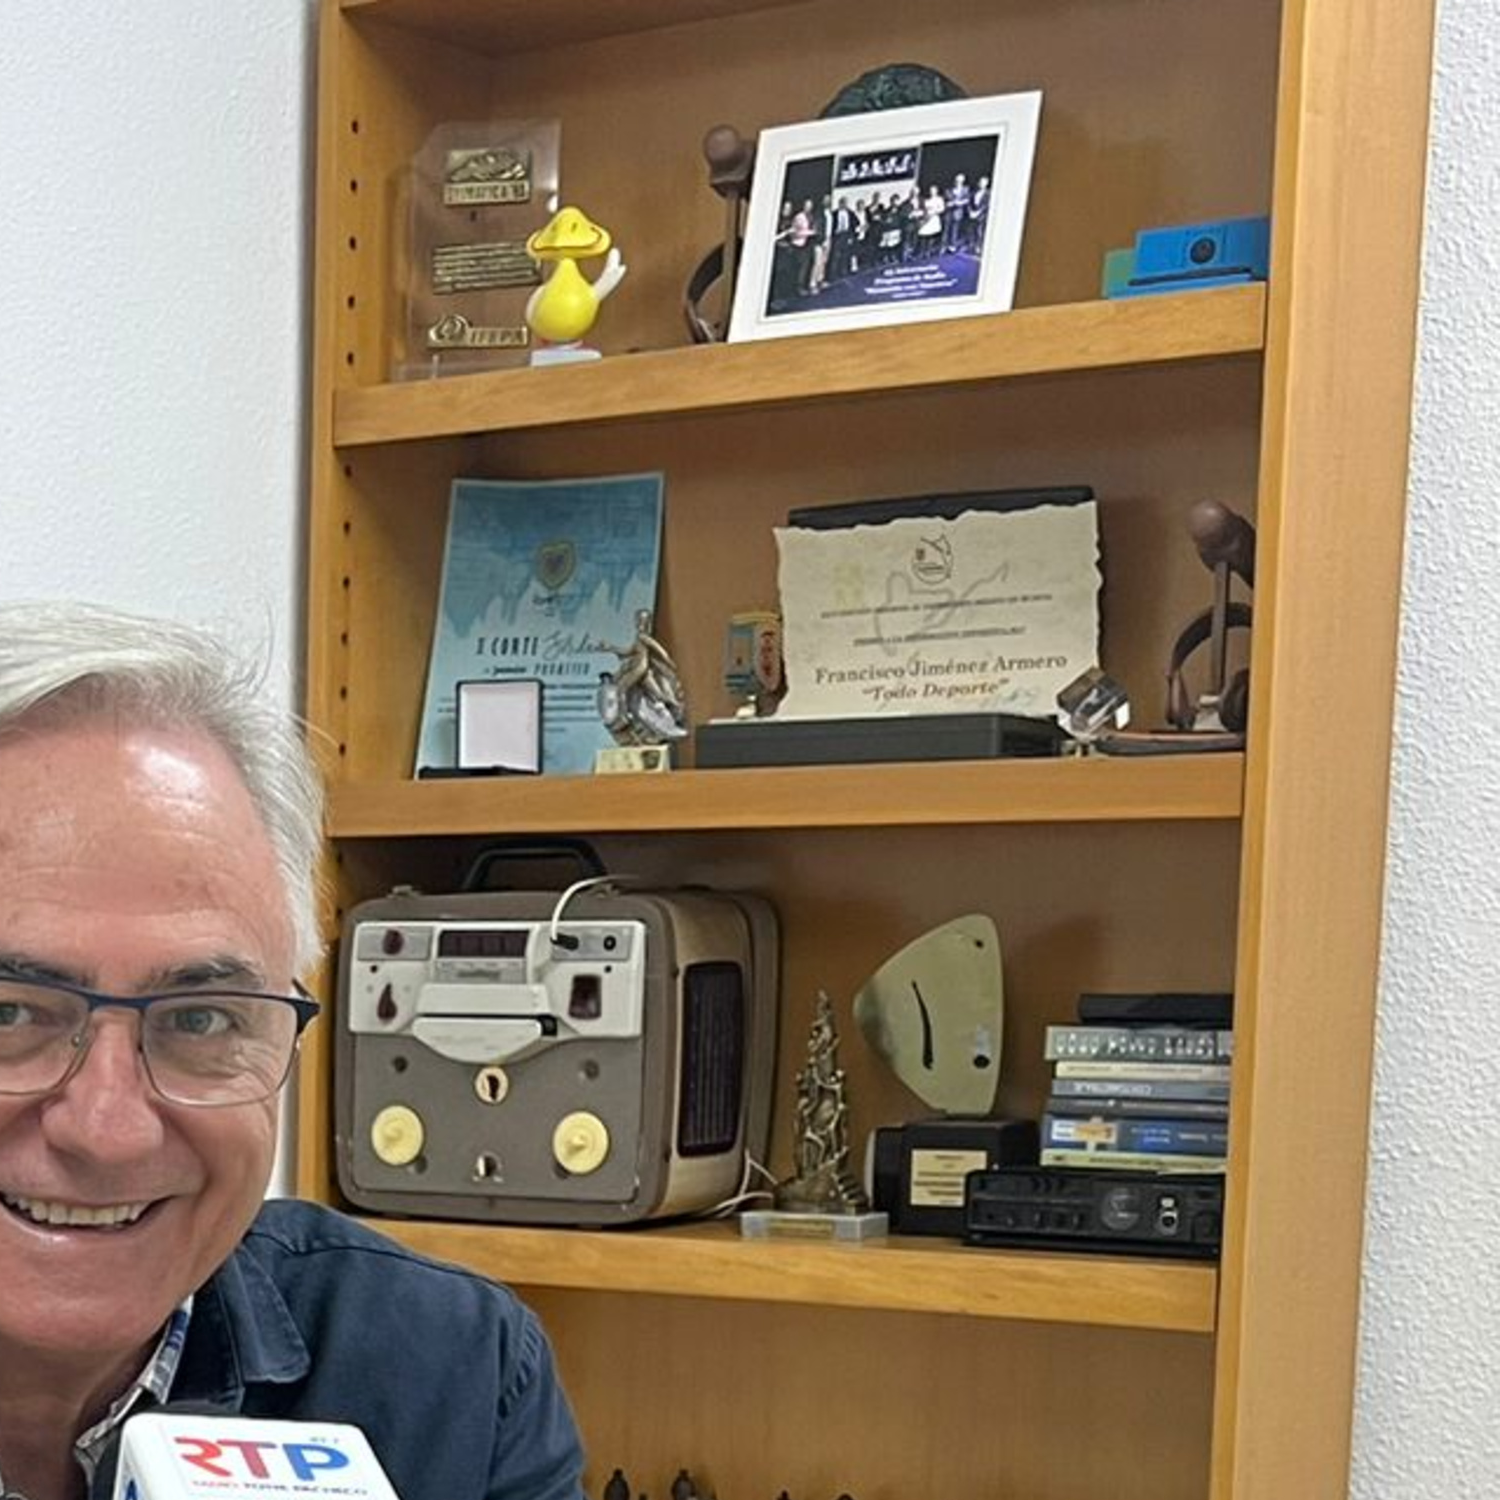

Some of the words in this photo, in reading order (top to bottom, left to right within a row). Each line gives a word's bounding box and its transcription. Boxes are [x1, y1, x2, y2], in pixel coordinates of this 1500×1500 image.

[814, 662, 906, 685] Francisco
[907, 657, 988, 679] Jiménez
[992, 654, 1068, 673] Armero
[174, 1436, 350, 1481] RTP
